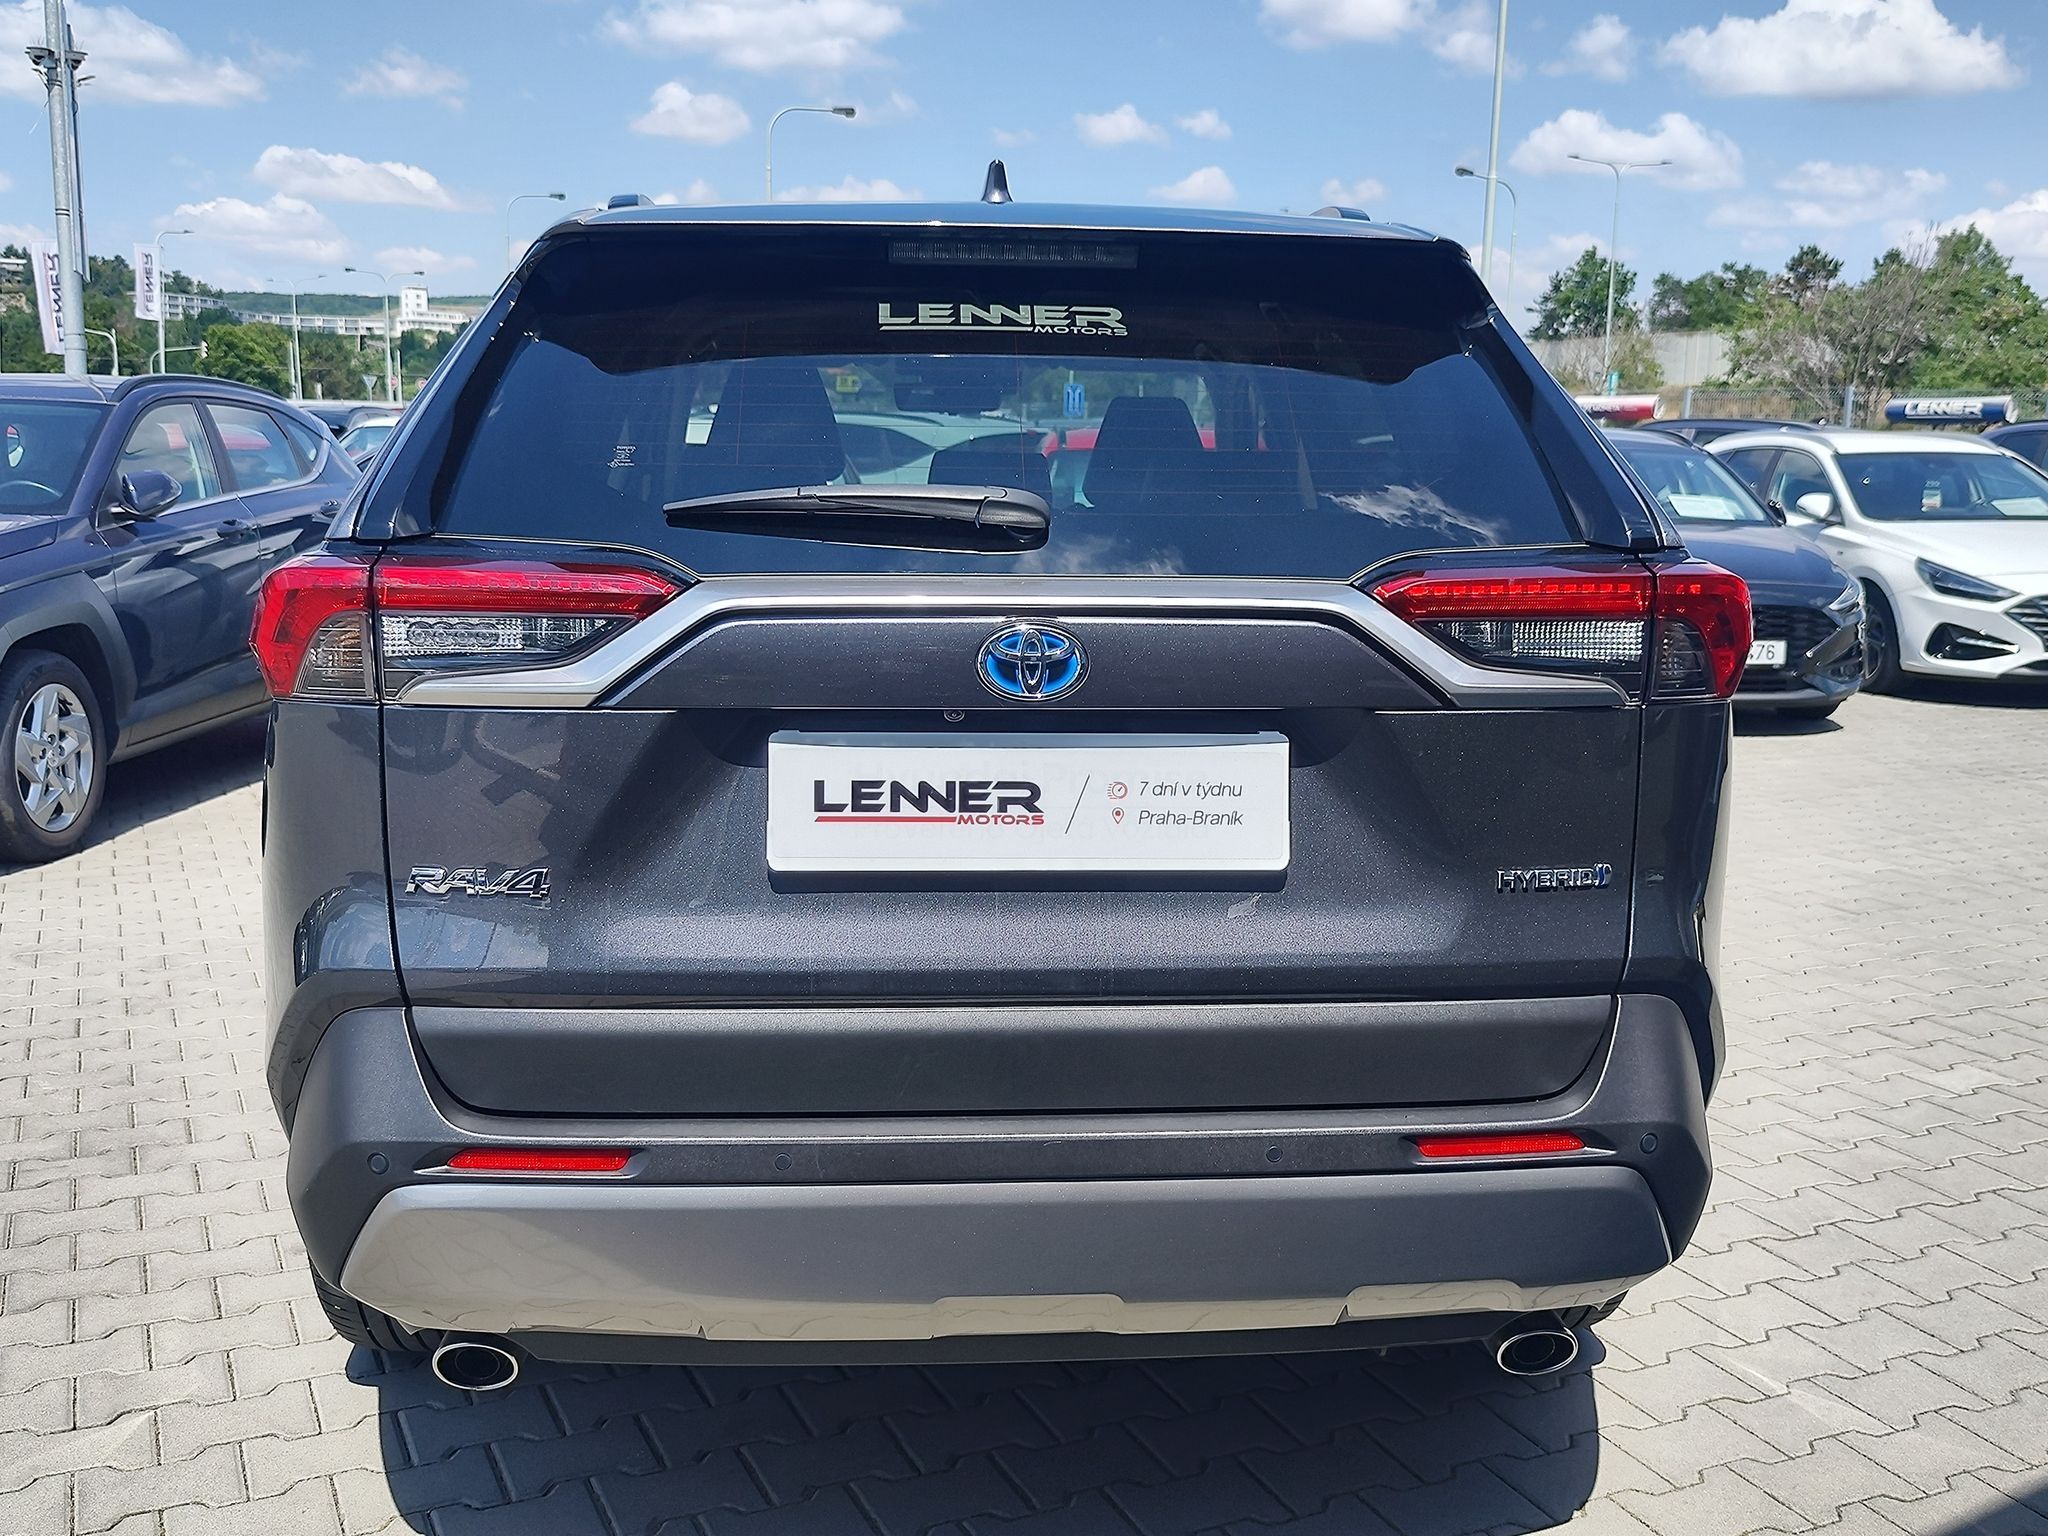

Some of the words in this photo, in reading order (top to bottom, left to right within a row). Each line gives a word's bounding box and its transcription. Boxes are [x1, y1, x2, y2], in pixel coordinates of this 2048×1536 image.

[878, 302, 1126, 328] LENNER
[1033, 325, 1128, 336] MOTORS
[1904, 400, 1983, 416] LENNER
[1749, 644, 1775, 660] 76
[813, 779, 1044, 813] LENNER
[1139, 782, 1150, 797] 7
[1152, 780, 1178, 797] dní
[1181, 785, 1192, 797] v
[1196, 780, 1243, 801] týdnu
[957, 814, 1045, 826] MOTORS
[1138, 808, 1244, 826] Praha-Braník
[405, 867, 551, 898] RAV4
[1496, 868, 1596, 890] HYBRID
